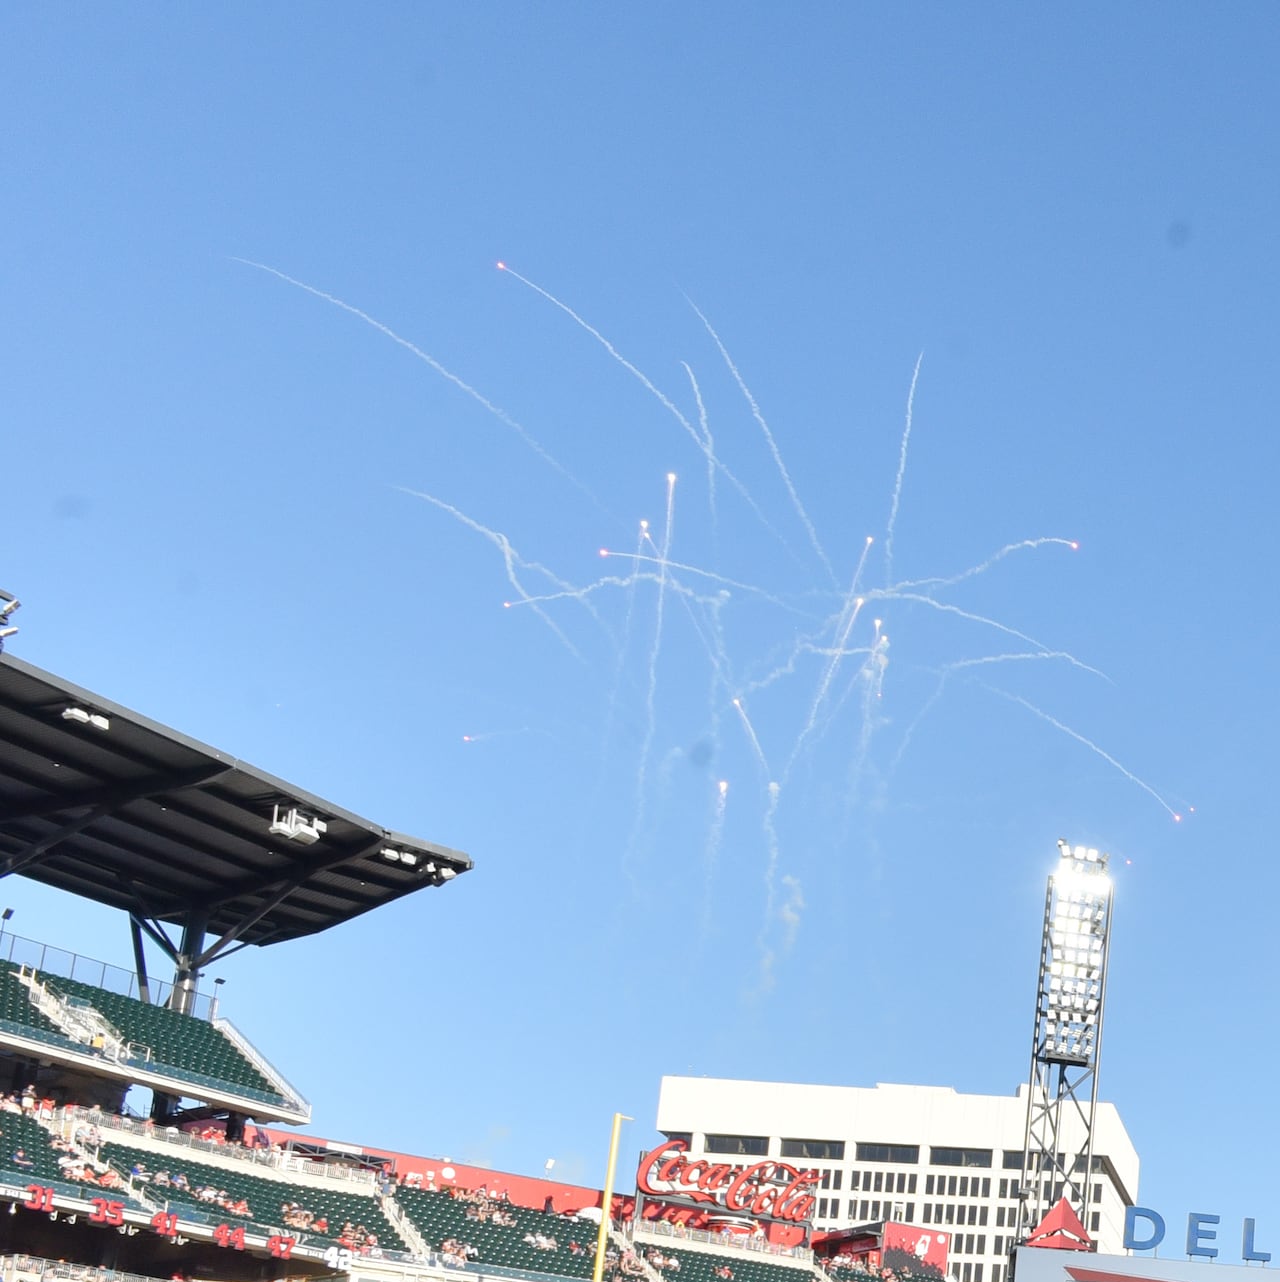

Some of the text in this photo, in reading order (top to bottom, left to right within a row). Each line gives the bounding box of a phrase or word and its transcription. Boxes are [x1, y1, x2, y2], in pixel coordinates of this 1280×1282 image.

[25, 1184, 54, 1212] 31
[90, 1198, 124, 1225] 35
[151, 1211, 178, 1236] 41
[213, 1223, 245, 1250] 44
[266, 1235, 296, 1259] 47
[324, 1246, 352, 1269] 42
